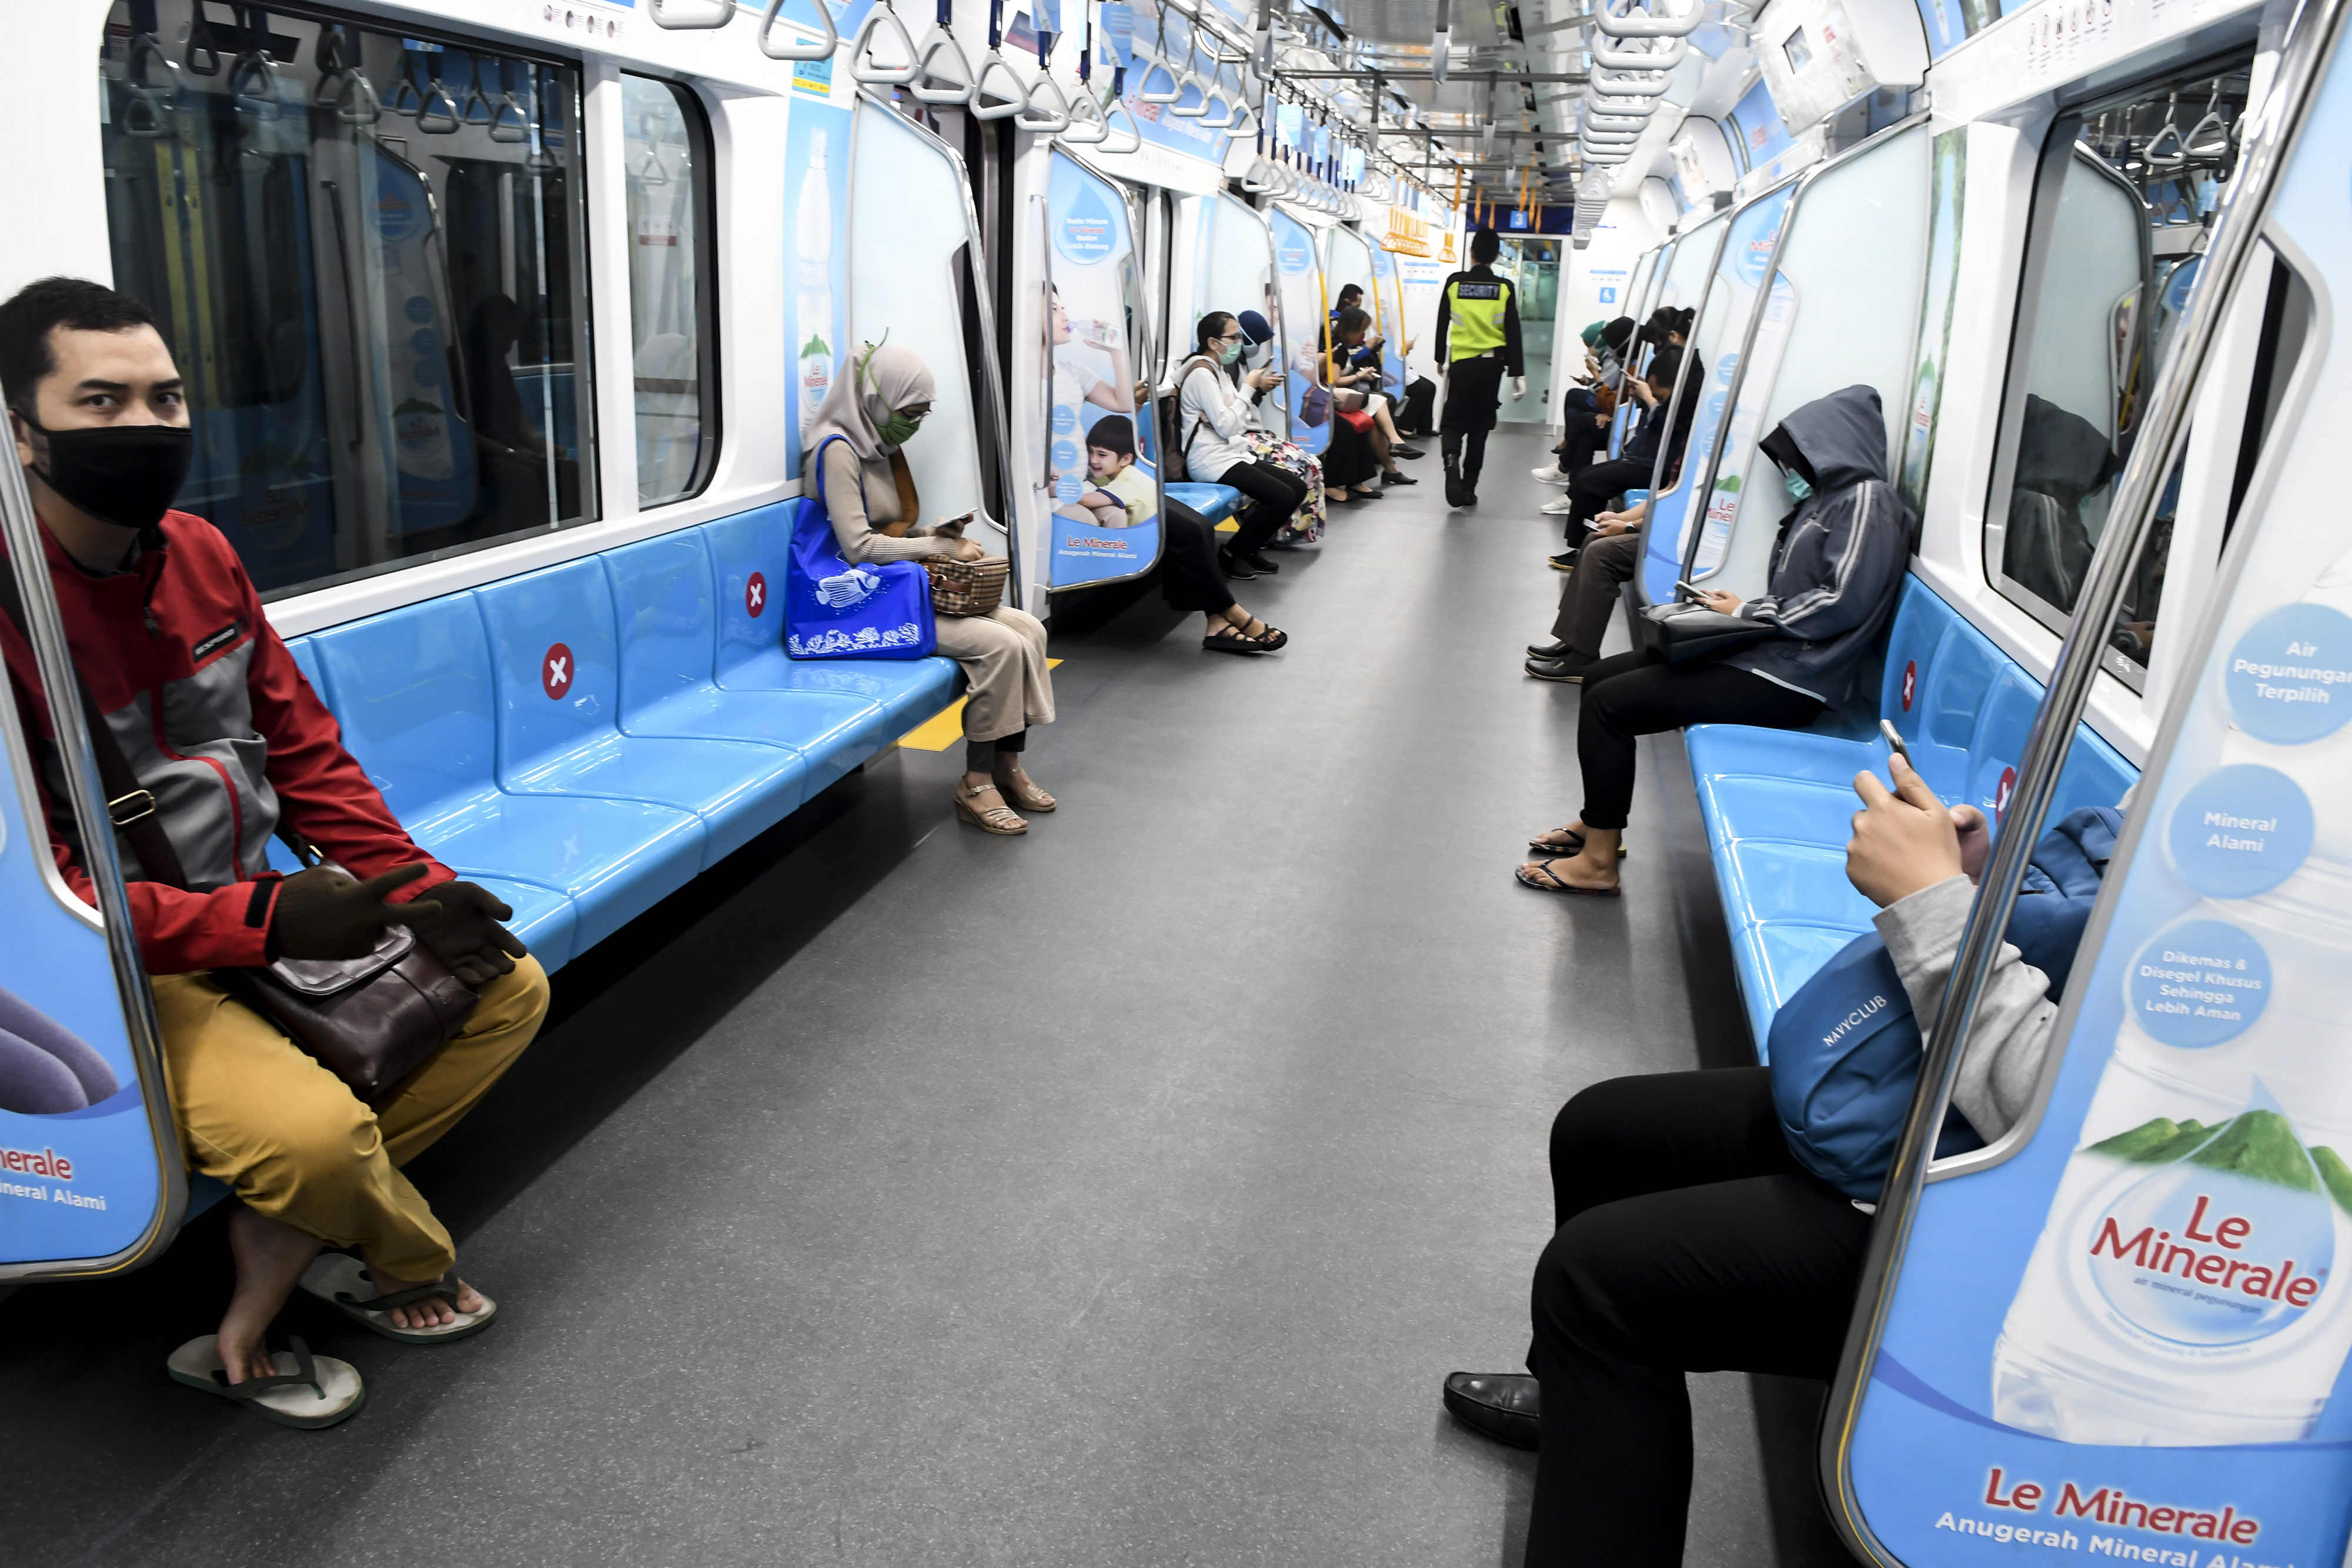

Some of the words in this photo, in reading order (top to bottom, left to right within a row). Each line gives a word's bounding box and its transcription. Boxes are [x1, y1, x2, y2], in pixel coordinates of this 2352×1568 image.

[1515, 212, 1524, 226] 3
[1458, 284, 1499, 298] SECURITY
[811, 362, 820, 376] Le
[1719, 497, 1735, 511] Le
[1067, 535, 1081, 547] Le
[1083, 537, 1128, 550] Minerale
[2285, 641, 2318, 657] Air
[2255, 683, 2330, 704] Terpilih
[2204, 811, 2277, 832] Mineral
[2206, 833, 2265, 852] Alami
[2162, 951, 2231, 969] Dikemas
[2235, 959, 2247, 971] &
[2140, 965, 2201, 983] Disegel
[2204, 972, 2262, 989] Khusus
[2159, 984, 2235, 1004] Sehingga
[2145, 999, 2190, 1015] Lebih
[2193, 1005, 2241, 1021] Aman
[1822, 995, 1887, 1047] NAVYCLUB
[53, 1188, 106, 1211] Alami
[2184, 1195, 2251, 1249] Le
[2089, 1216, 2318, 1307] Minerale
[1985, 1468, 2042, 1511] Le
[2054, 1482, 2258, 1544] Minerale
[1933, 1511, 2079, 1551] Anugerah
[2088, 1534, 2198, 1568] Mineral
